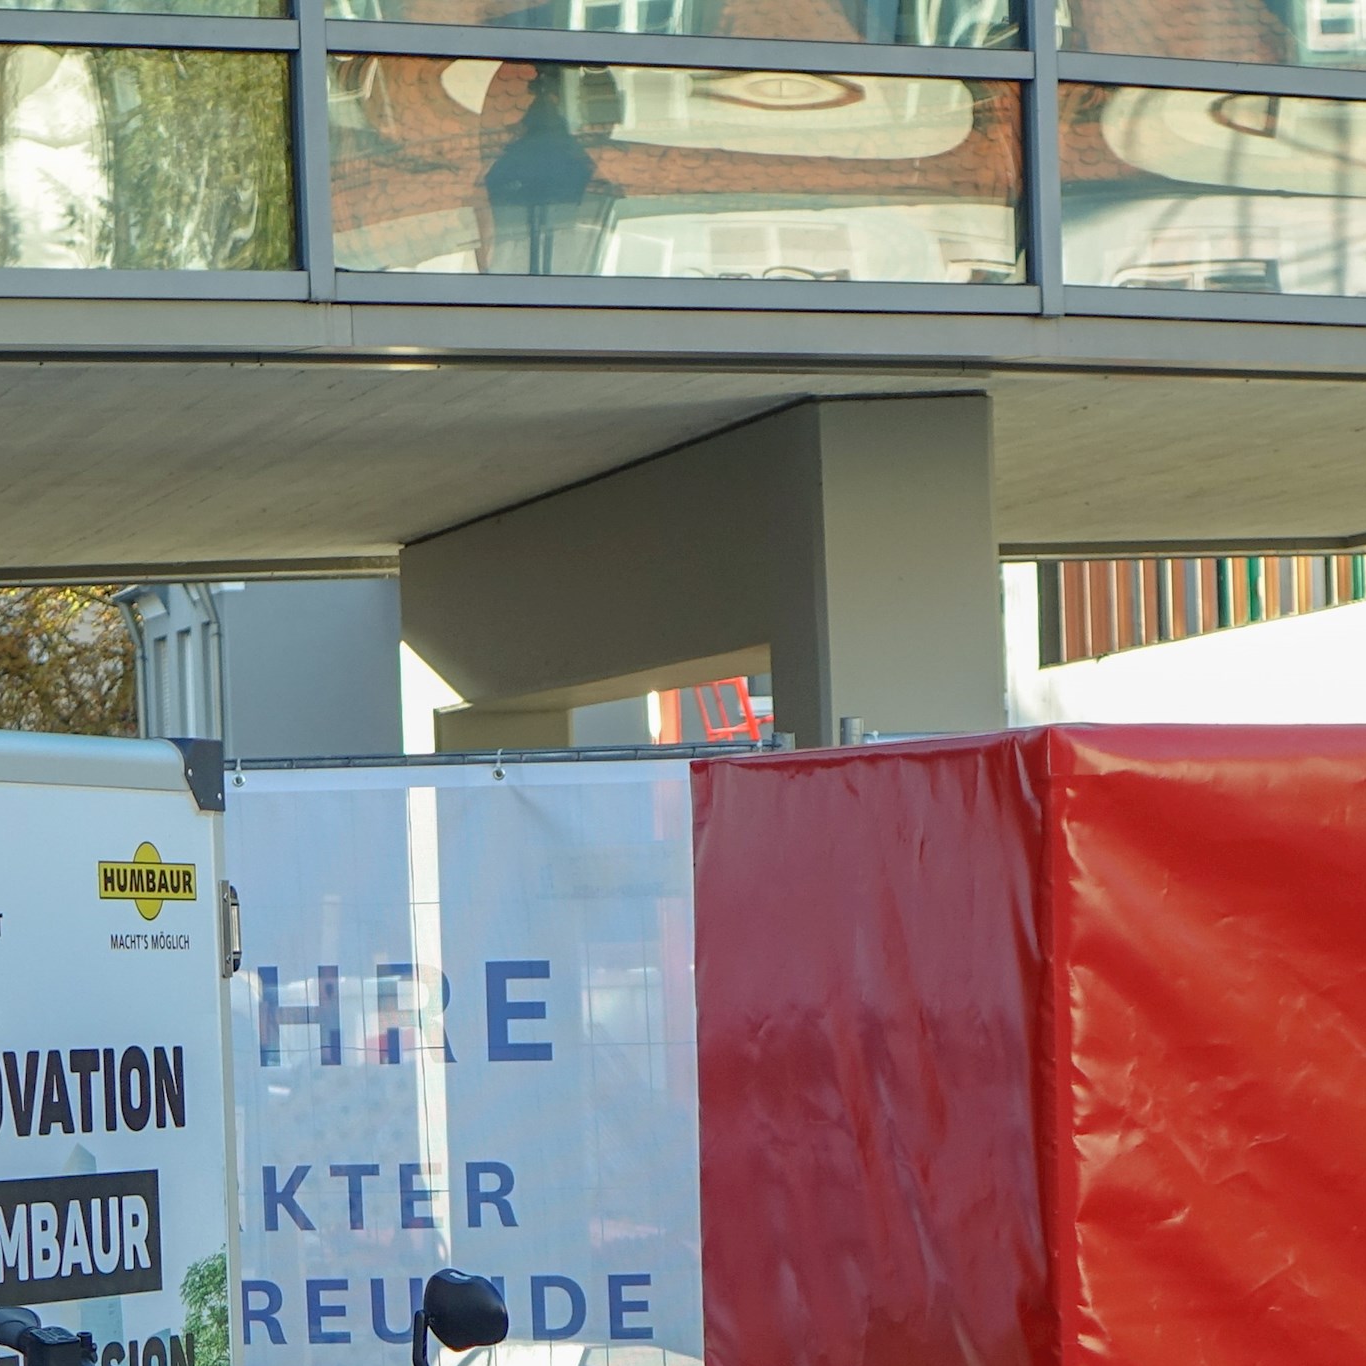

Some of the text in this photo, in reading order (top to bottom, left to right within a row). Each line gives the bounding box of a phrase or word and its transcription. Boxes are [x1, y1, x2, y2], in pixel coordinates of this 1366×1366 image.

[103, 867, 193, 894] HUMBAUR
[110, 932, 190, 950] MACHT'S MÖGLICH
[239, 1161, 519, 1232] KTER
[242, 1273, 654, 1346] REUDE
